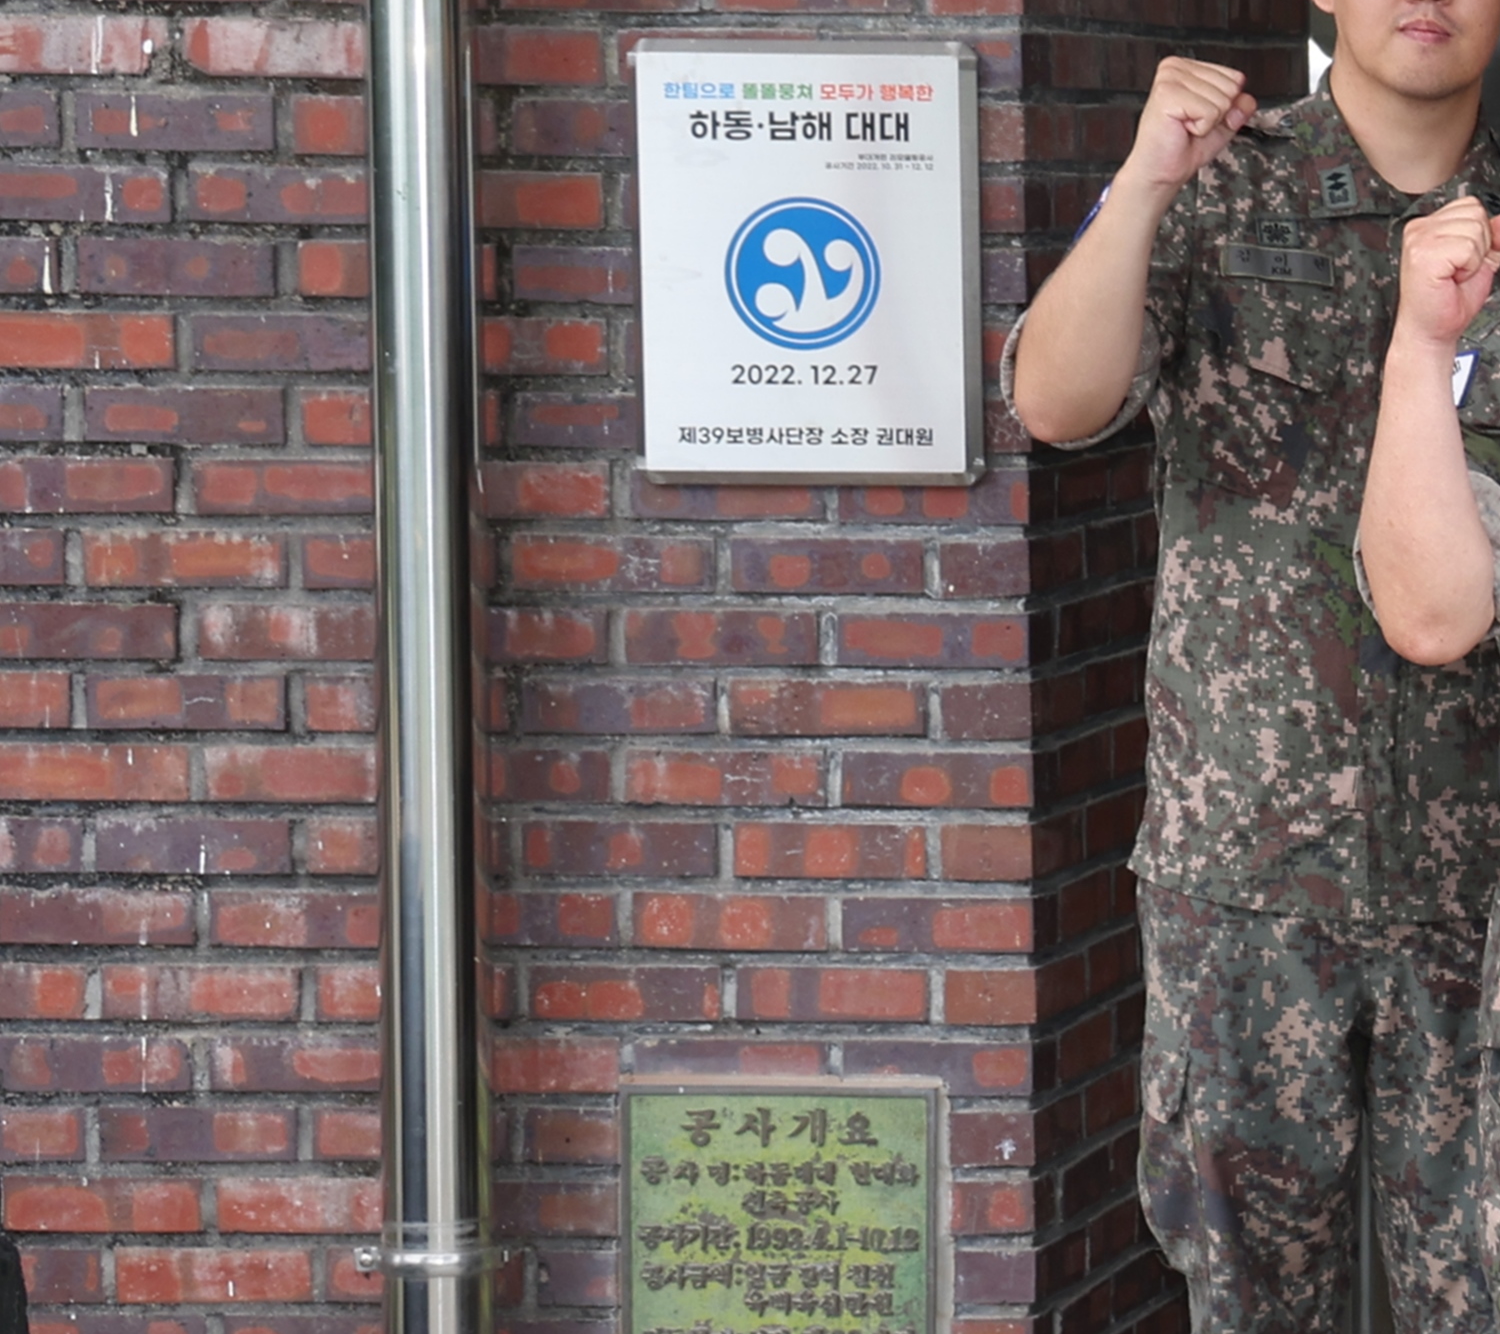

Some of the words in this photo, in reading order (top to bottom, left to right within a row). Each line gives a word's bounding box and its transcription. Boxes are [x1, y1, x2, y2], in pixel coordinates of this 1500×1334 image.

[663, 81, 735, 100] 한팀으로
[820, 83, 873, 101] 모두가
[879, 83, 934, 102] 행복한
[690, 110, 832, 142] 하동·남해
[845, 111, 910, 143] 대대
[731, 364, 802, 385] 2022.
[678, 427, 824, 445] 제39보병사단장
[831, 427, 869, 446] 소장
[876, 428, 934, 446] 권대원
[680, 1107, 879, 1148] 공사개요
